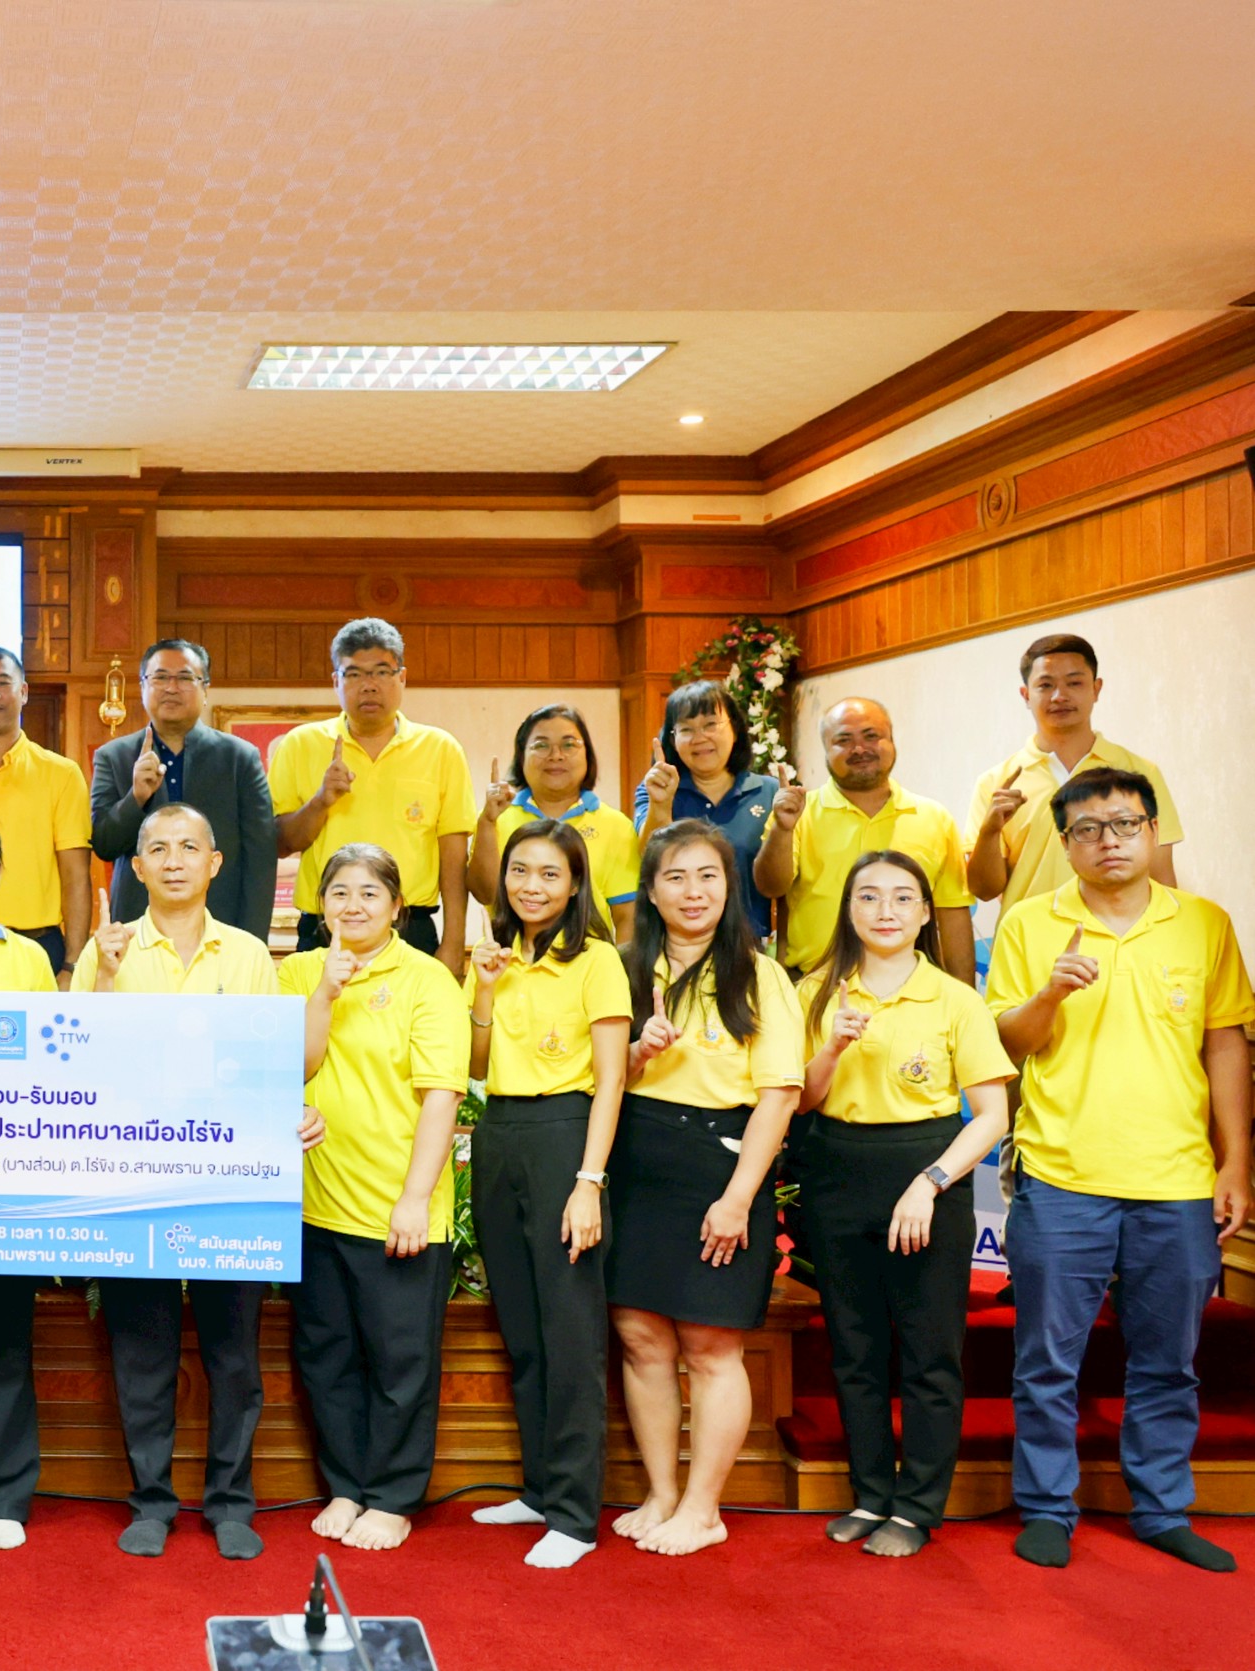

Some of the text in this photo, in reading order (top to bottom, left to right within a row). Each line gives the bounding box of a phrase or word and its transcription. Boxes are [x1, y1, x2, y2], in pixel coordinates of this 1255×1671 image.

[60, 1032, 90, 1044] TTW
[2, 1155, 66, 1174] (บางส่วน)
[70, 1155, 115, 1174] ต.ไร่ขิง
[119, 1161, 202, 1175] อ.สามพราน
[207, 1160, 280, 1180] จ.นครปฐม
[10, 1227, 43, 1240] เวลา
[47, 1227, 90, 1241] 10.30
[93, 1229, 108, 1241] น.
[199, 1235, 282, 1256] สนับสนุนโดย
[59, 1248, 134, 1267] จ.นครปฐม
[178, 1257, 211, 1269] บมจ.
